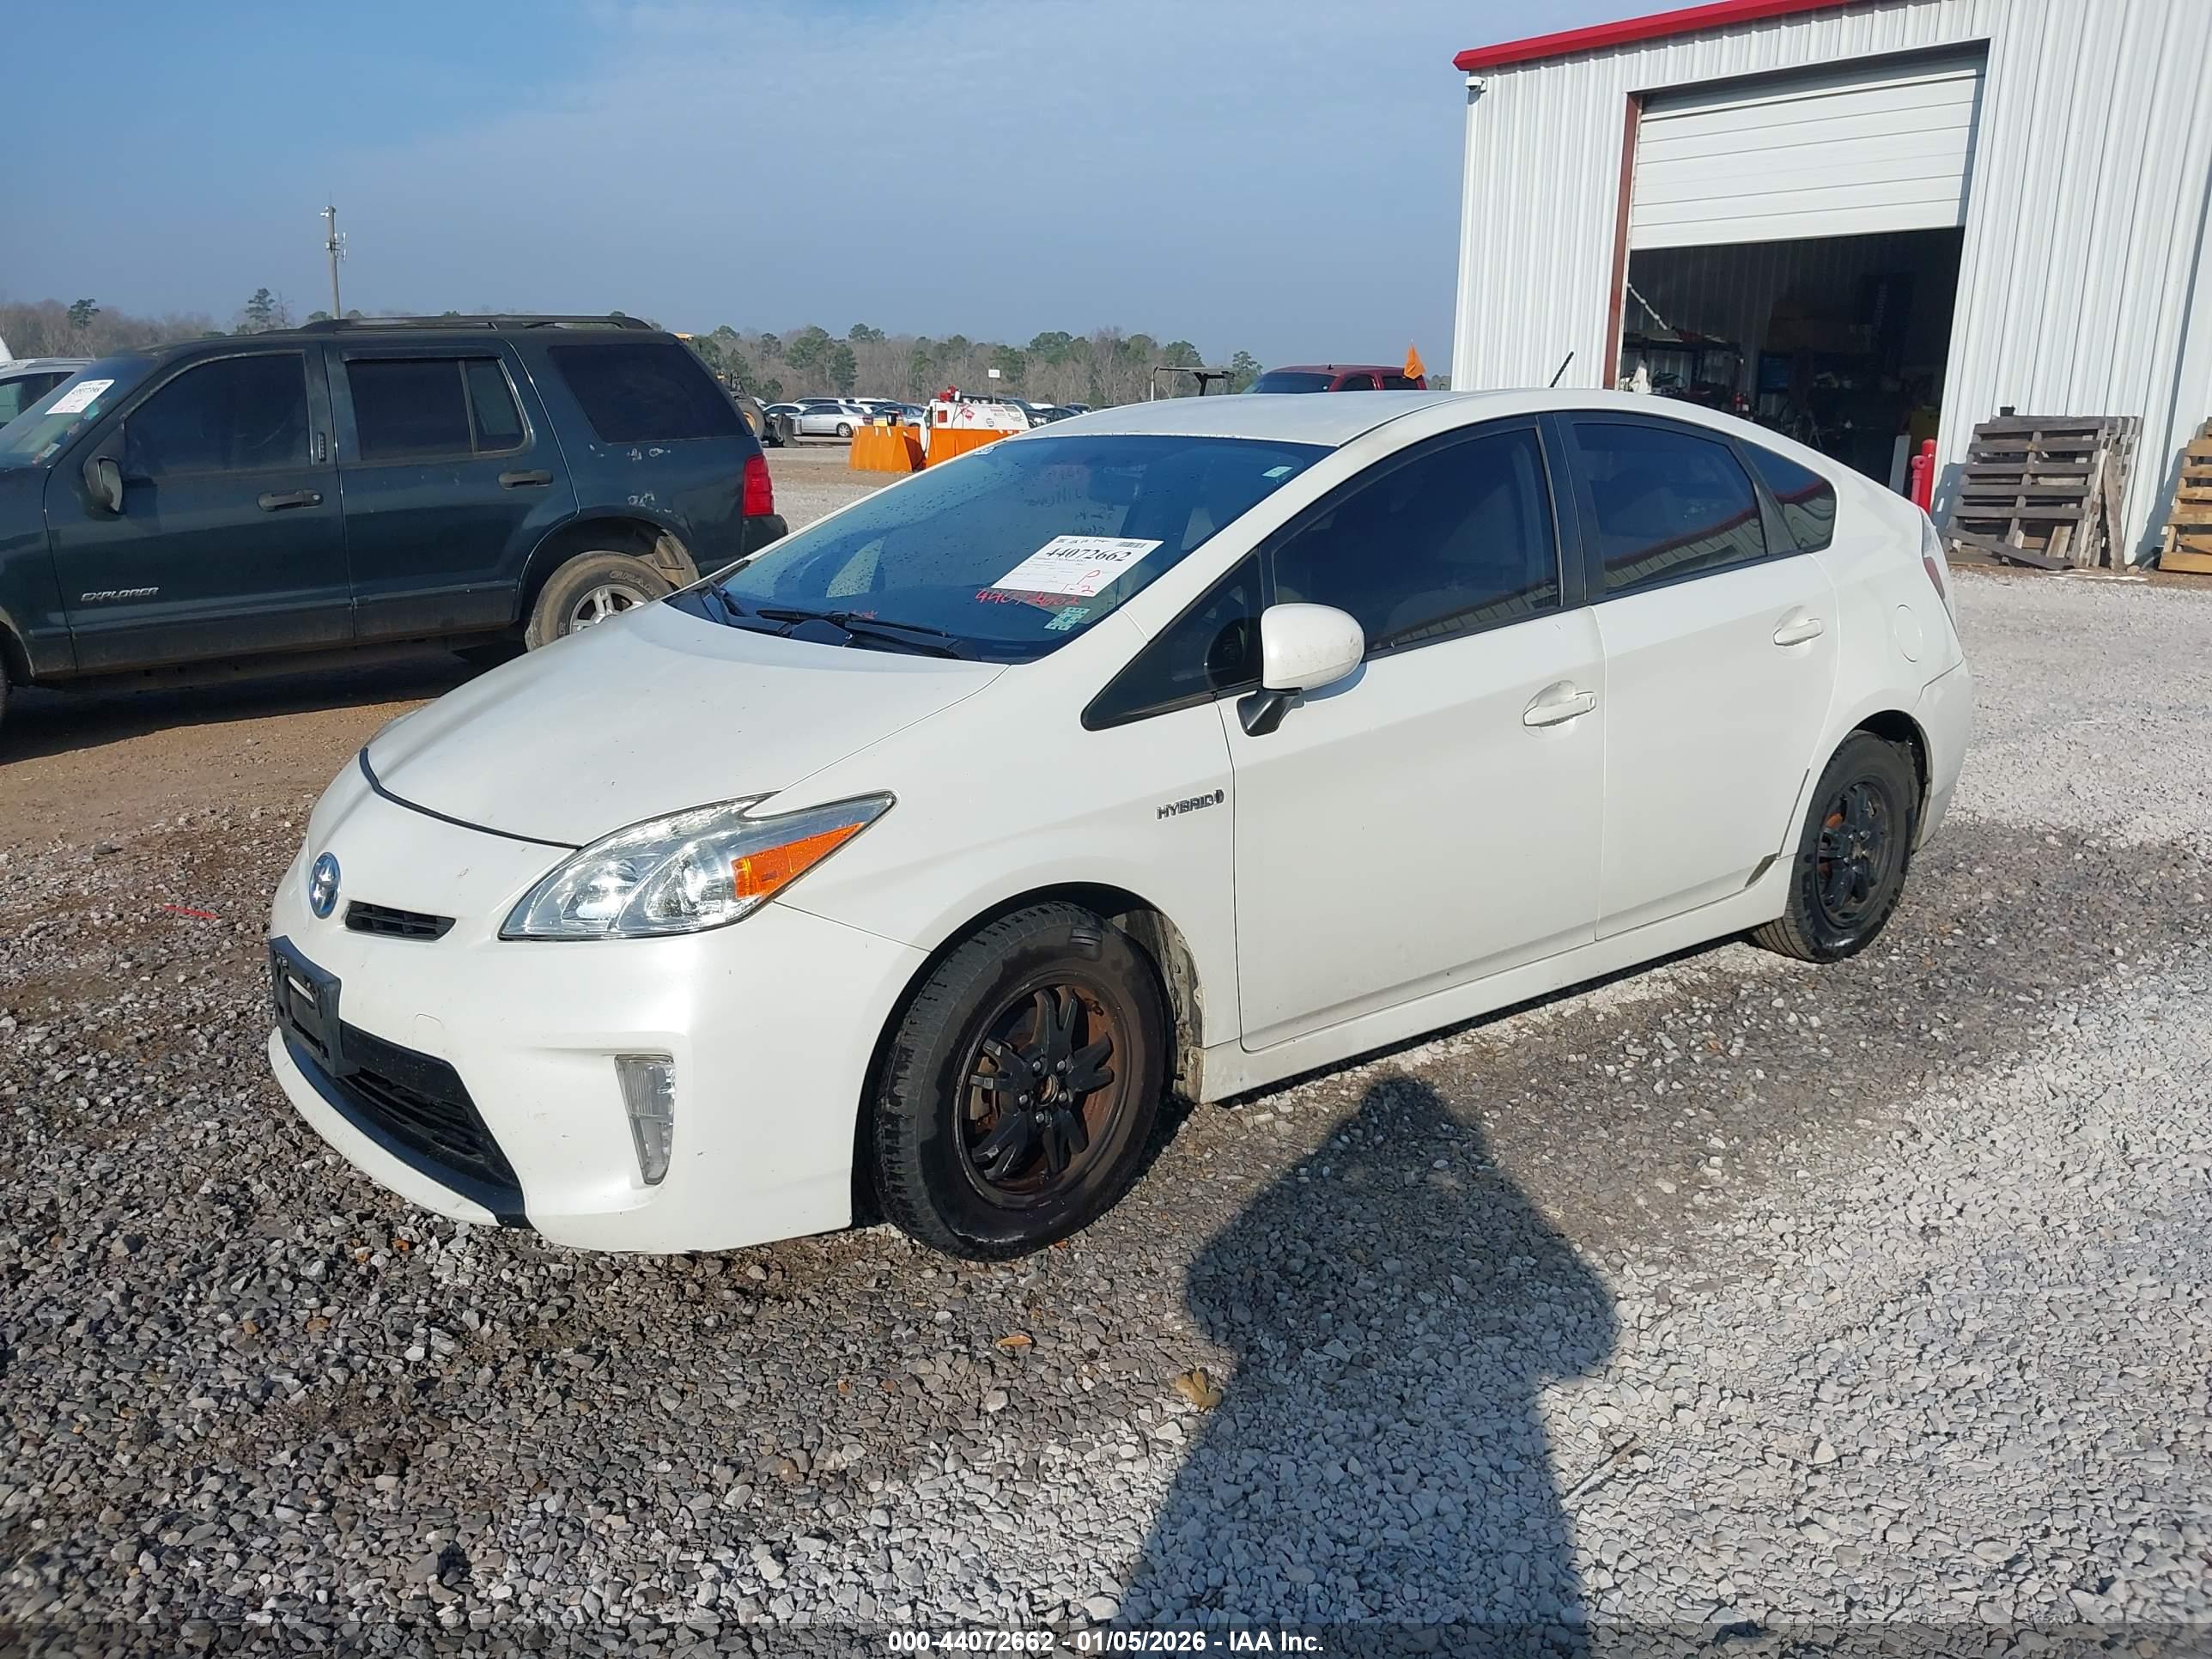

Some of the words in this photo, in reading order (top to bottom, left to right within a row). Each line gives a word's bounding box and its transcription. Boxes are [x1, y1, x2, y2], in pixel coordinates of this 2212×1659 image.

[1045, 546, 1133, 562] 44072662
[81, 586, 159, 602] EXPLORER
[1156, 793, 1214, 819] HYBRID
